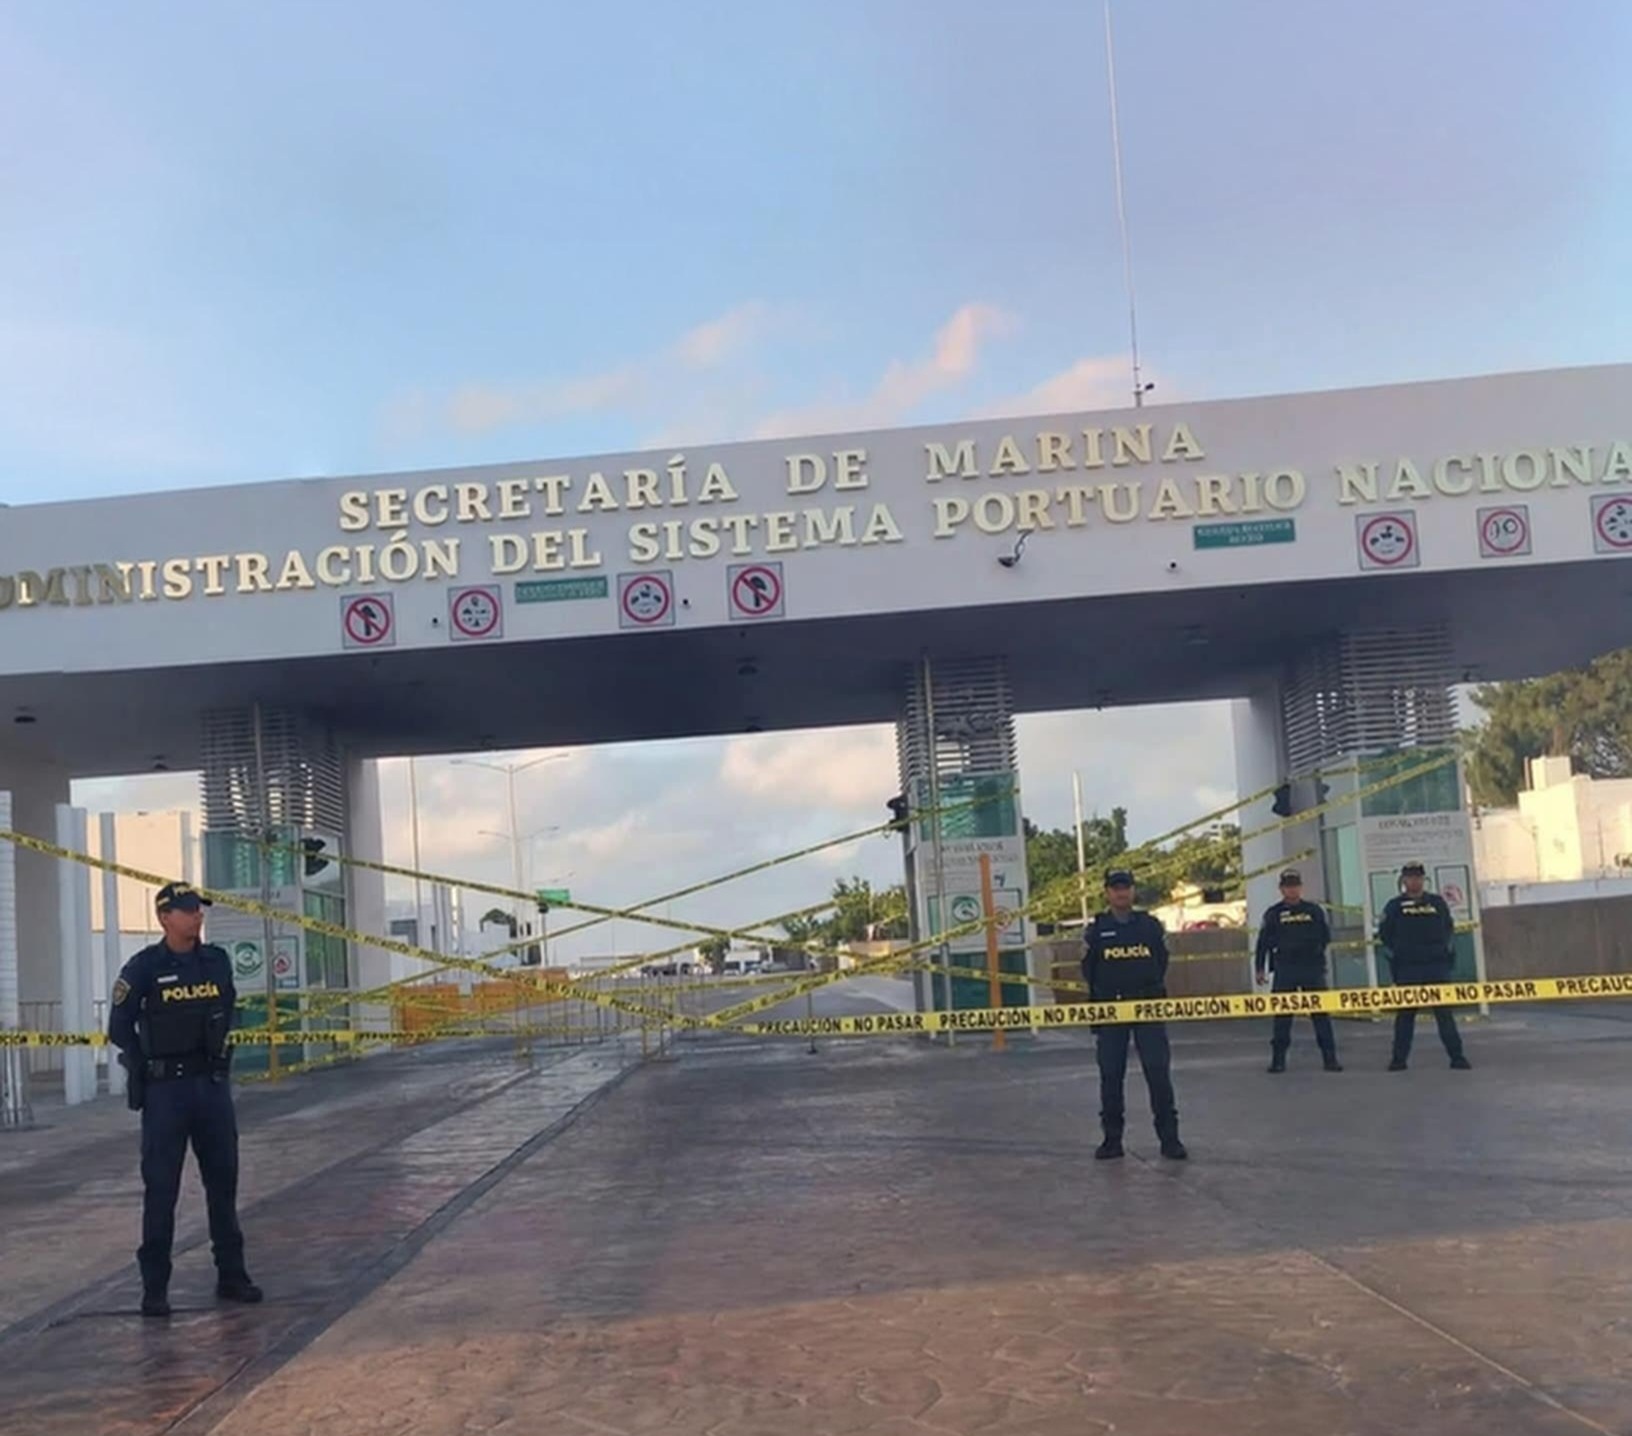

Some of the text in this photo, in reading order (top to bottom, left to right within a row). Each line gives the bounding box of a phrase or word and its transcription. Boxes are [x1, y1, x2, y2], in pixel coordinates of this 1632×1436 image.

[339, 422, 1205, 532] SECRETARÍA DE MARINA
[489, 527, 603, 575] DEL
[629, 502, 904, 564] SISTEMA
[933, 468, 1306, 539] PORTUARIO
[162, 982, 219, 1003] POLICÍA
[1340, 986, 1441, 1008] PRECAUCIÓN
[1456, 986, 1478, 1001] NO
[1483, 982, 1537, 998] PASAR
[939, 1007, 1031, 1029] PRECAUCIÓN
[1043, 1007, 1065, 1025] NO
[1068, 1005, 1118, 1022] PASAR
[1134, 996, 1231, 1019] PRECAUCIÓN
[1244, 997, 1266, 1013] NO
[1270, 994, 1322, 1012] PASAR
[853, 1016, 873, 1033] NO
[877, 1014, 924, 1031] PASAR
